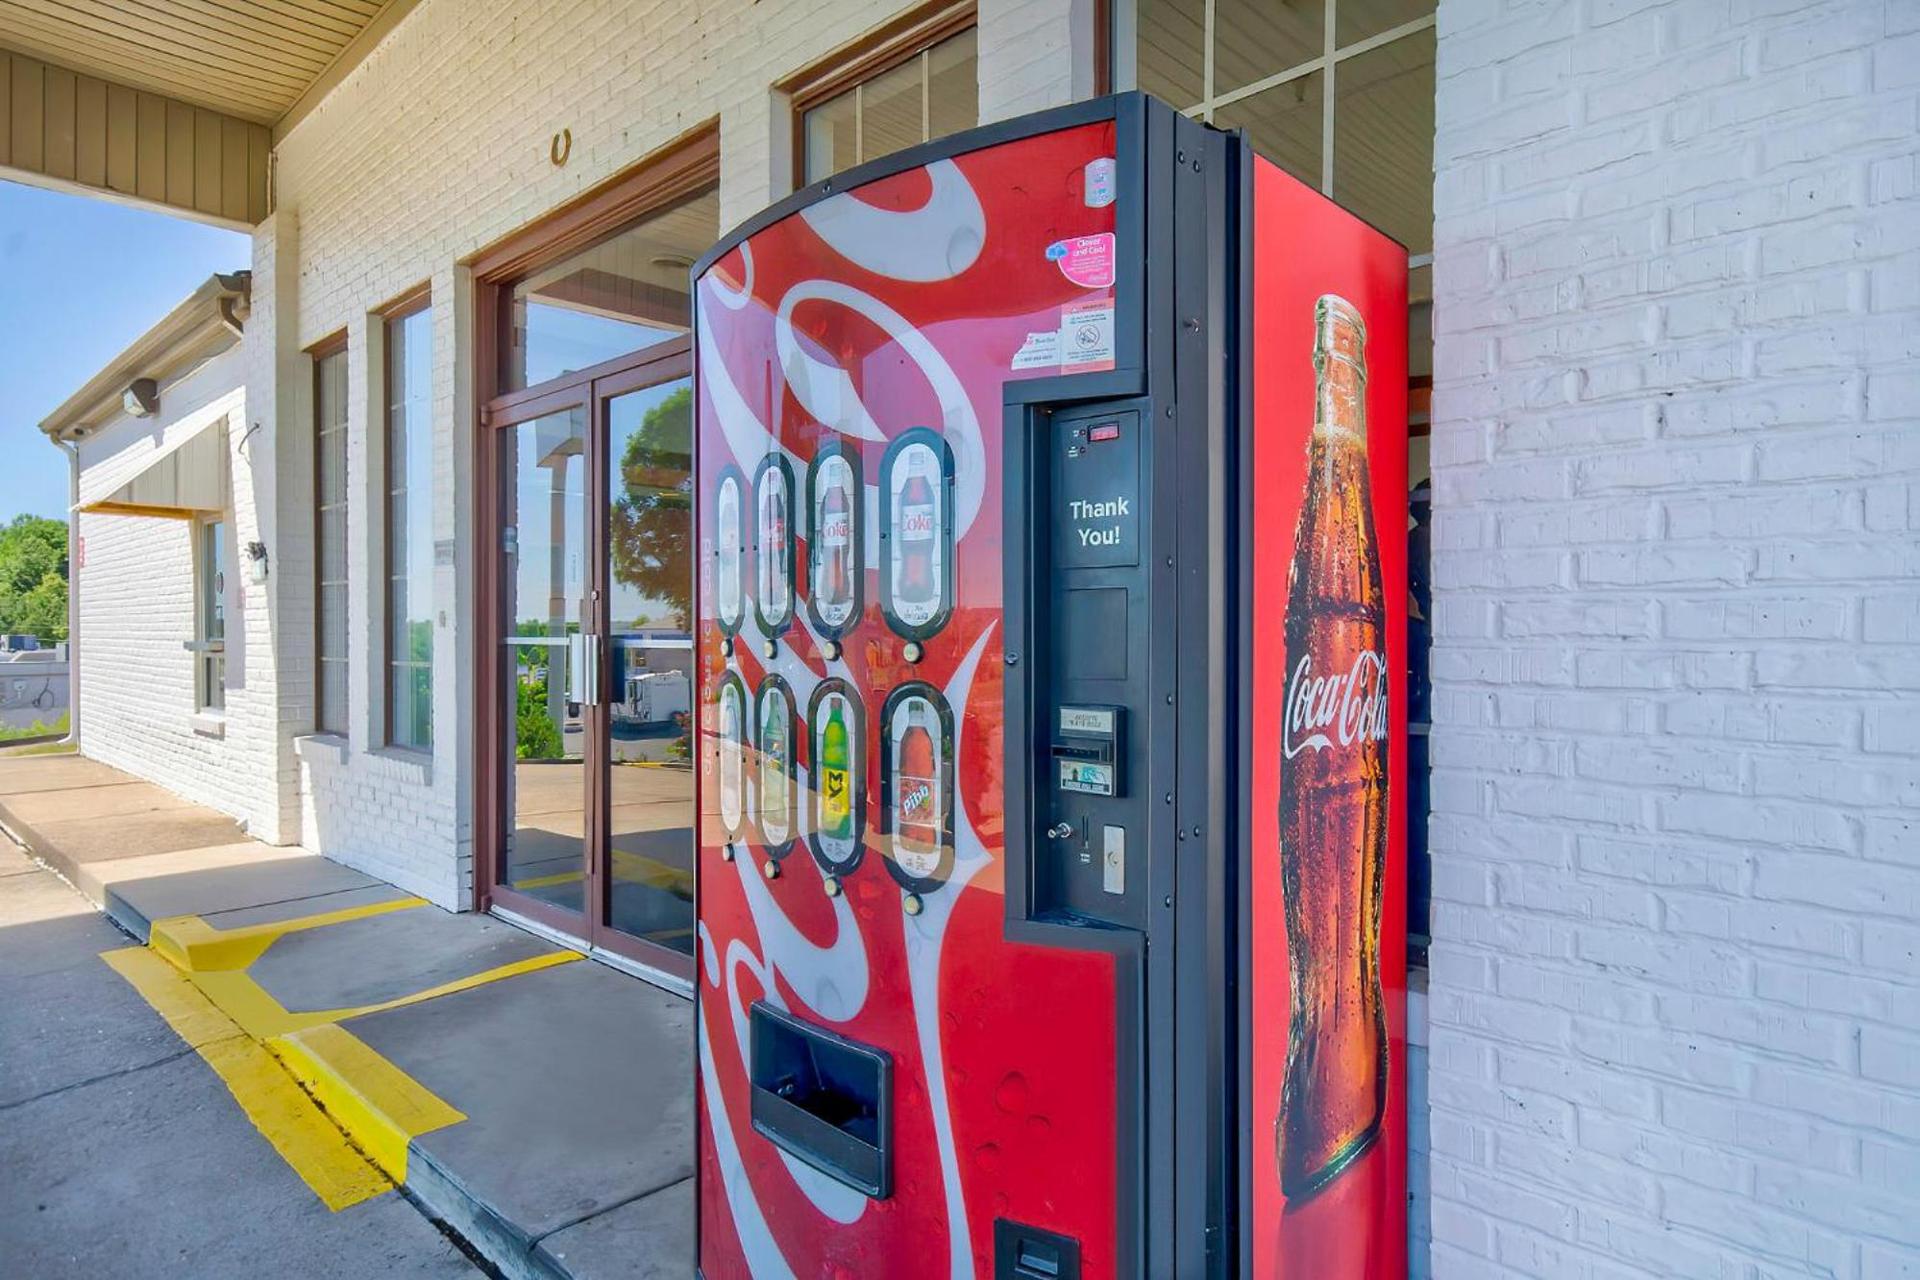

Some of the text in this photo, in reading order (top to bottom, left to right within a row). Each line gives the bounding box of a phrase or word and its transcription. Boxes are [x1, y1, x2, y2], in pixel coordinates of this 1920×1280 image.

[1069, 496, 1130, 519] Thank
[1078, 525, 1120, 547] You!
[702, 537, 712, 594] cold
[1284, 650, 1388, 760] Coca-Cola
